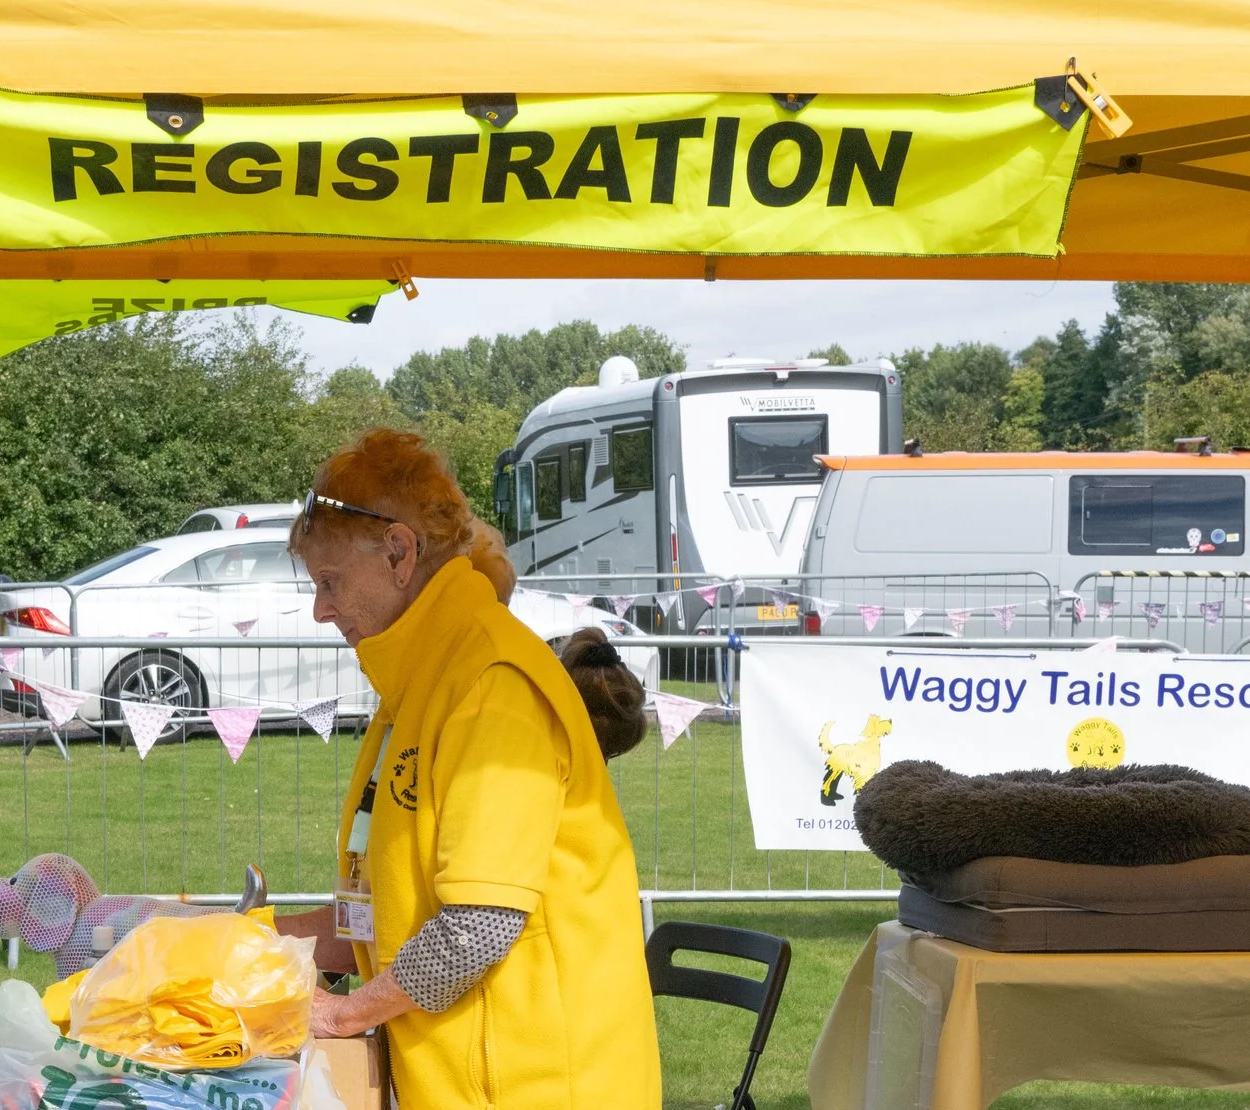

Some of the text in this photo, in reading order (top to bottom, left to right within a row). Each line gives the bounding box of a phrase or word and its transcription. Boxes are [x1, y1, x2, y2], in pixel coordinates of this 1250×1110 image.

[48, 116, 912, 208] REGISTRATION
[758, 398, 816, 408] MOBILVETTA
[880, 666, 1027, 713] Waggy
[1041, 671, 1141, 707] Tails
[1073, 722, 1119, 740] Waggy Tails
[795, 818, 814, 829] Tel
